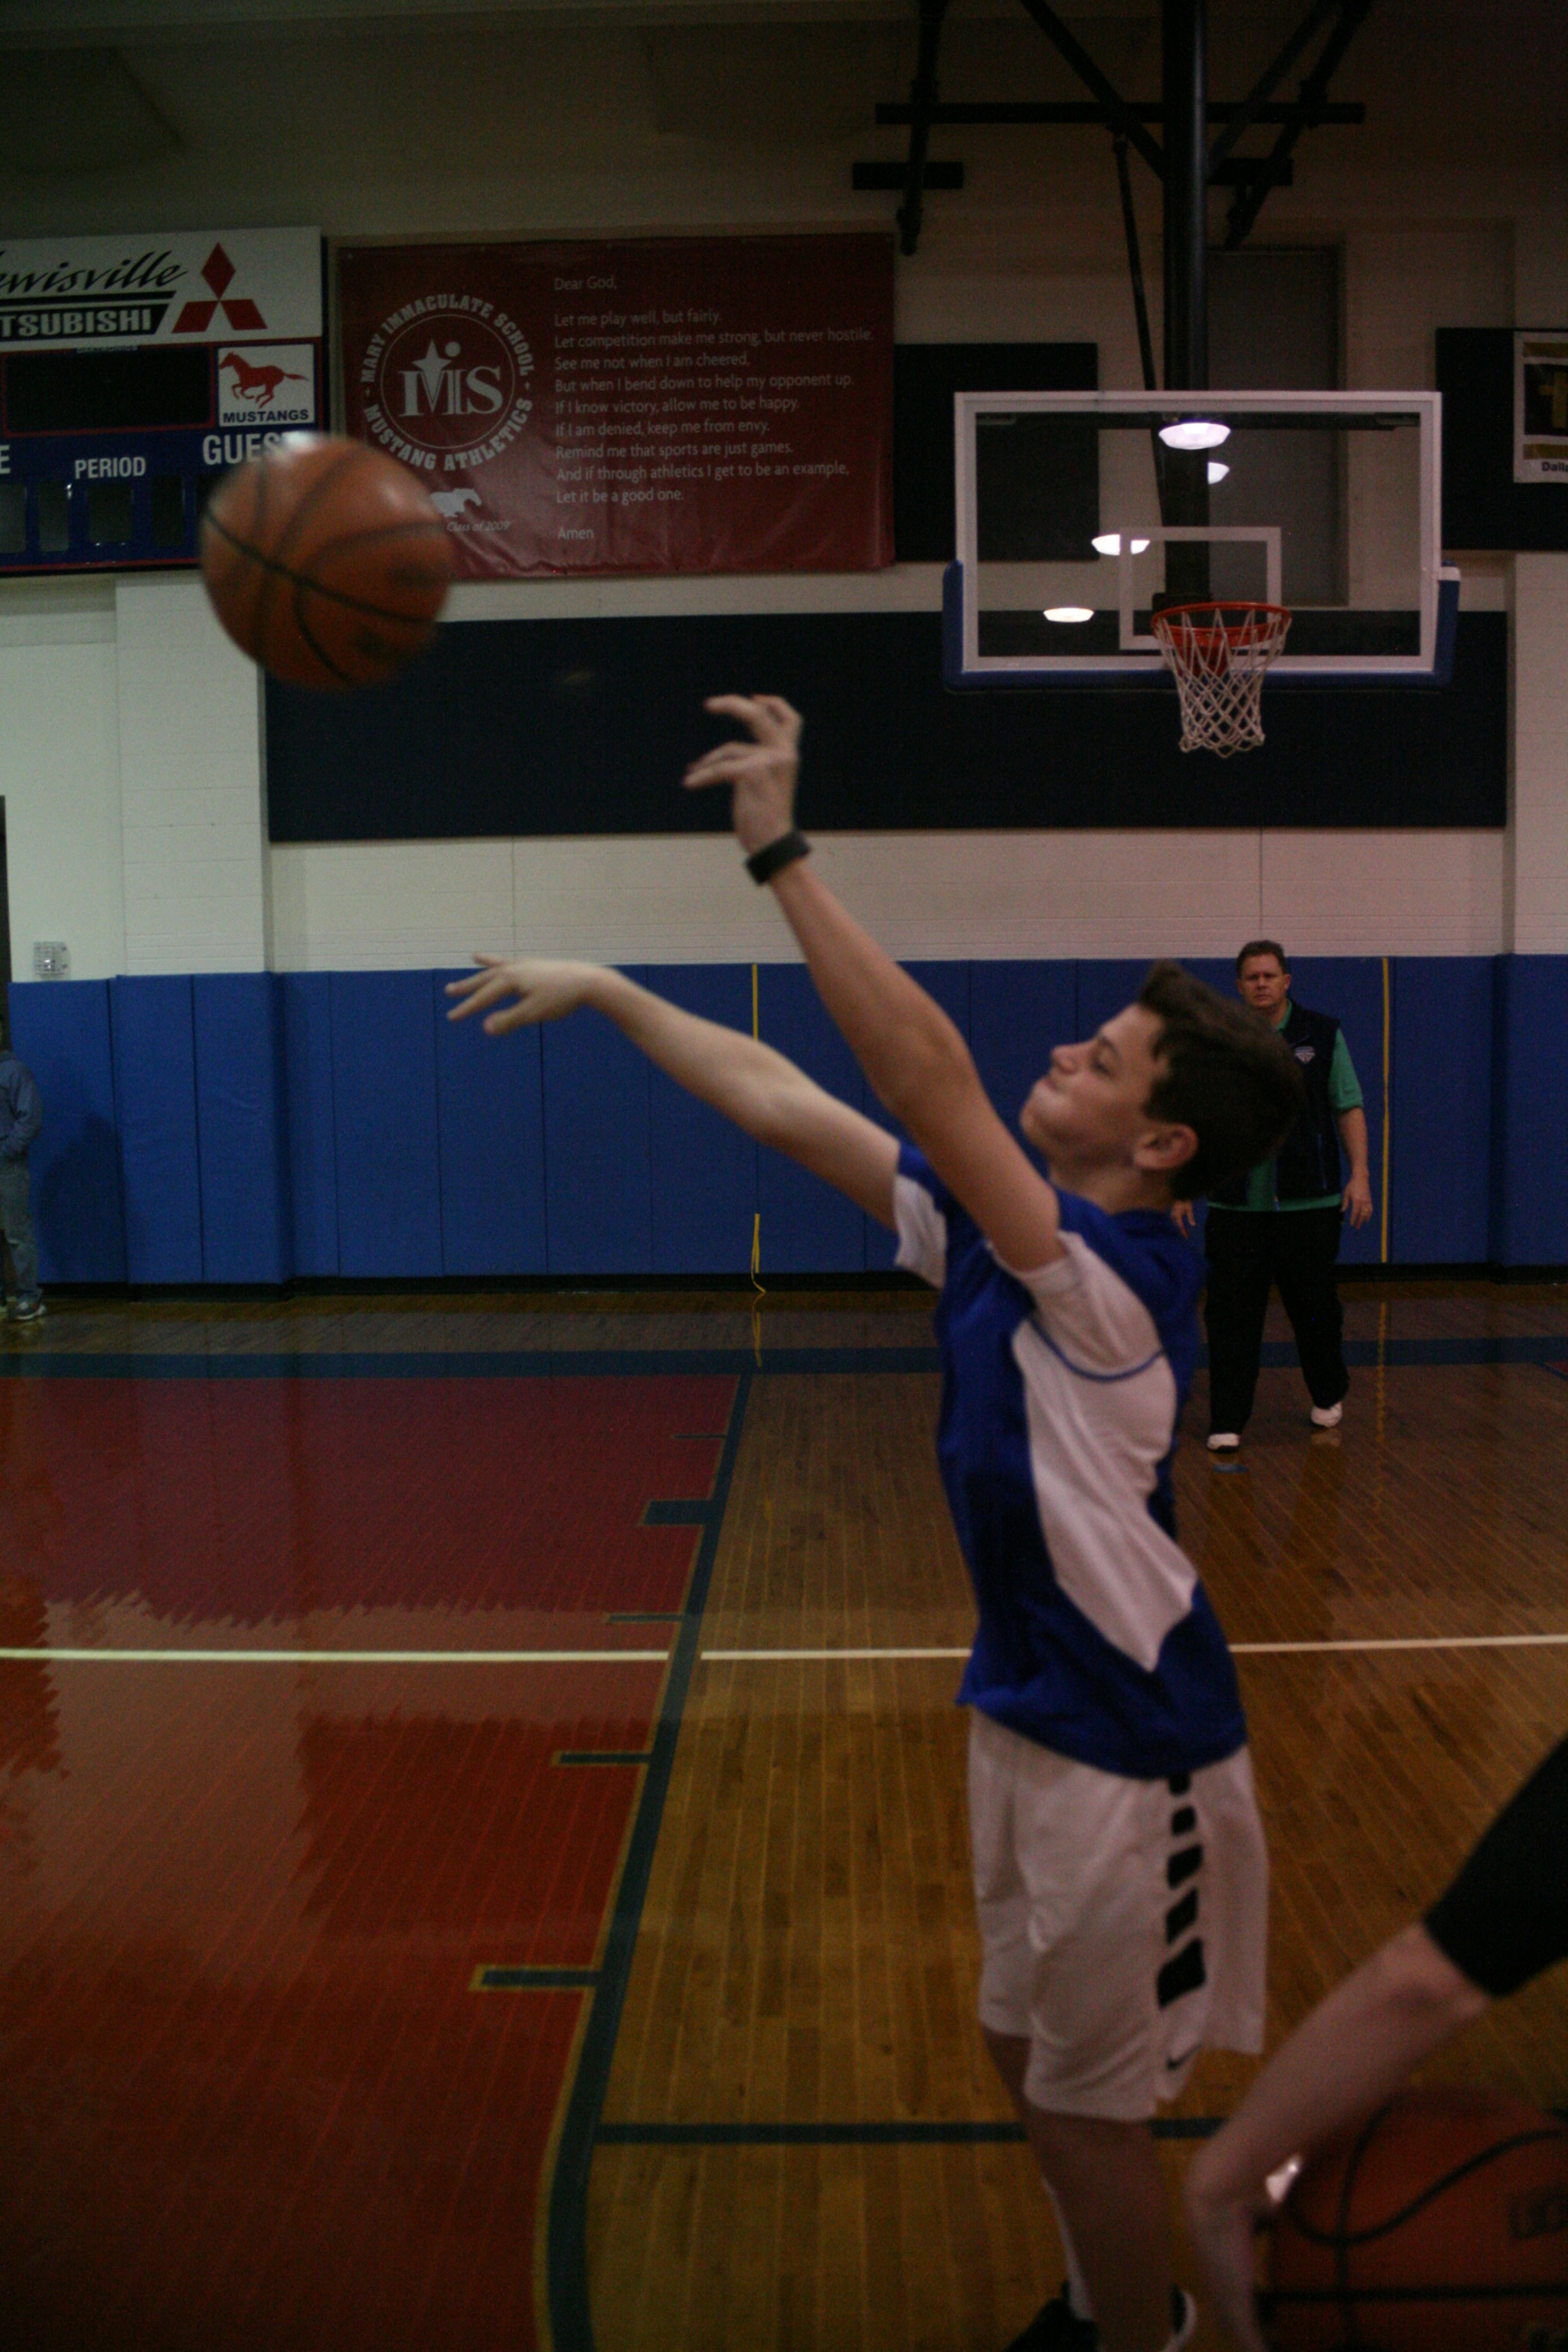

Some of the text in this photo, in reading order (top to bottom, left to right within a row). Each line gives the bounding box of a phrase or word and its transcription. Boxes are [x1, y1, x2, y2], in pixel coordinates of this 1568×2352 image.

[554, 274, 617, 290] Dear God,
[554, 313, 574, 327] Let
[577, 315, 597, 325] me
[601, 311, 626, 328] play
[631, 309, 659, 325] well,
[663, 309, 684, 323] but
[361, 293, 535, 383] MARY IMMACULATE SCHOOL
[554, 327, 874, 350] Let competition make me strong, but never hostile.
[555, 356, 577, 371] See
[580, 358, 600, 369] me
[603, 357, 626, 369] not
[629, 354, 662, 368] when
[673, 356, 692, 367] am
[696, 351, 750, 366] cheered.
[555, 378, 576, 392] But
[580, 377, 612, 391] when
[625, 376, 656, 390] bend
[660, 375, 694, 390] down
[698, 376, 712, 388] to
[715, 373, 743, 390] help
[746, 376, 766, 390] my
[769, 374, 832, 390] opponent
[556, 400, 565, 414] If
[575, 399, 608, 413] know
[662, 397, 696, 412] allow
[699, 399, 720, 410] me
[723, 398, 737, 410] to
[740, 395, 756, 409] be
[223, 409, 309, 423] MUSTANGS
[364, 397, 533, 471] MUSTANG ATHLETICS
[556, 423, 565, 436] If
[576, 425, 595, 436] am
[598, 421, 645, 436] denied,
[648, 420, 678, 437] keep
[681, 422, 701, 433] me
[704, 418, 734, 433] from
[738, 421, 770, 436] envy.
[202, 431, 288, 465] GUES
[556, 441, 793, 460] Remind me that sports are just games.
[75, 456, 146, 480] PERIOD
[557, 466, 581, 481] And
[585, 466, 594, 480] if
[598, 465, 647, 484] through
[650, 463, 704, 479] athletics
[714, 465, 734, 482] get
[738, 464, 753, 476] to
[756, 461, 772, 476] be
[774, 464, 789, 475] an
[557, 486, 684, 505] Let it be a good one.
[446, 521, 470, 532] Class
